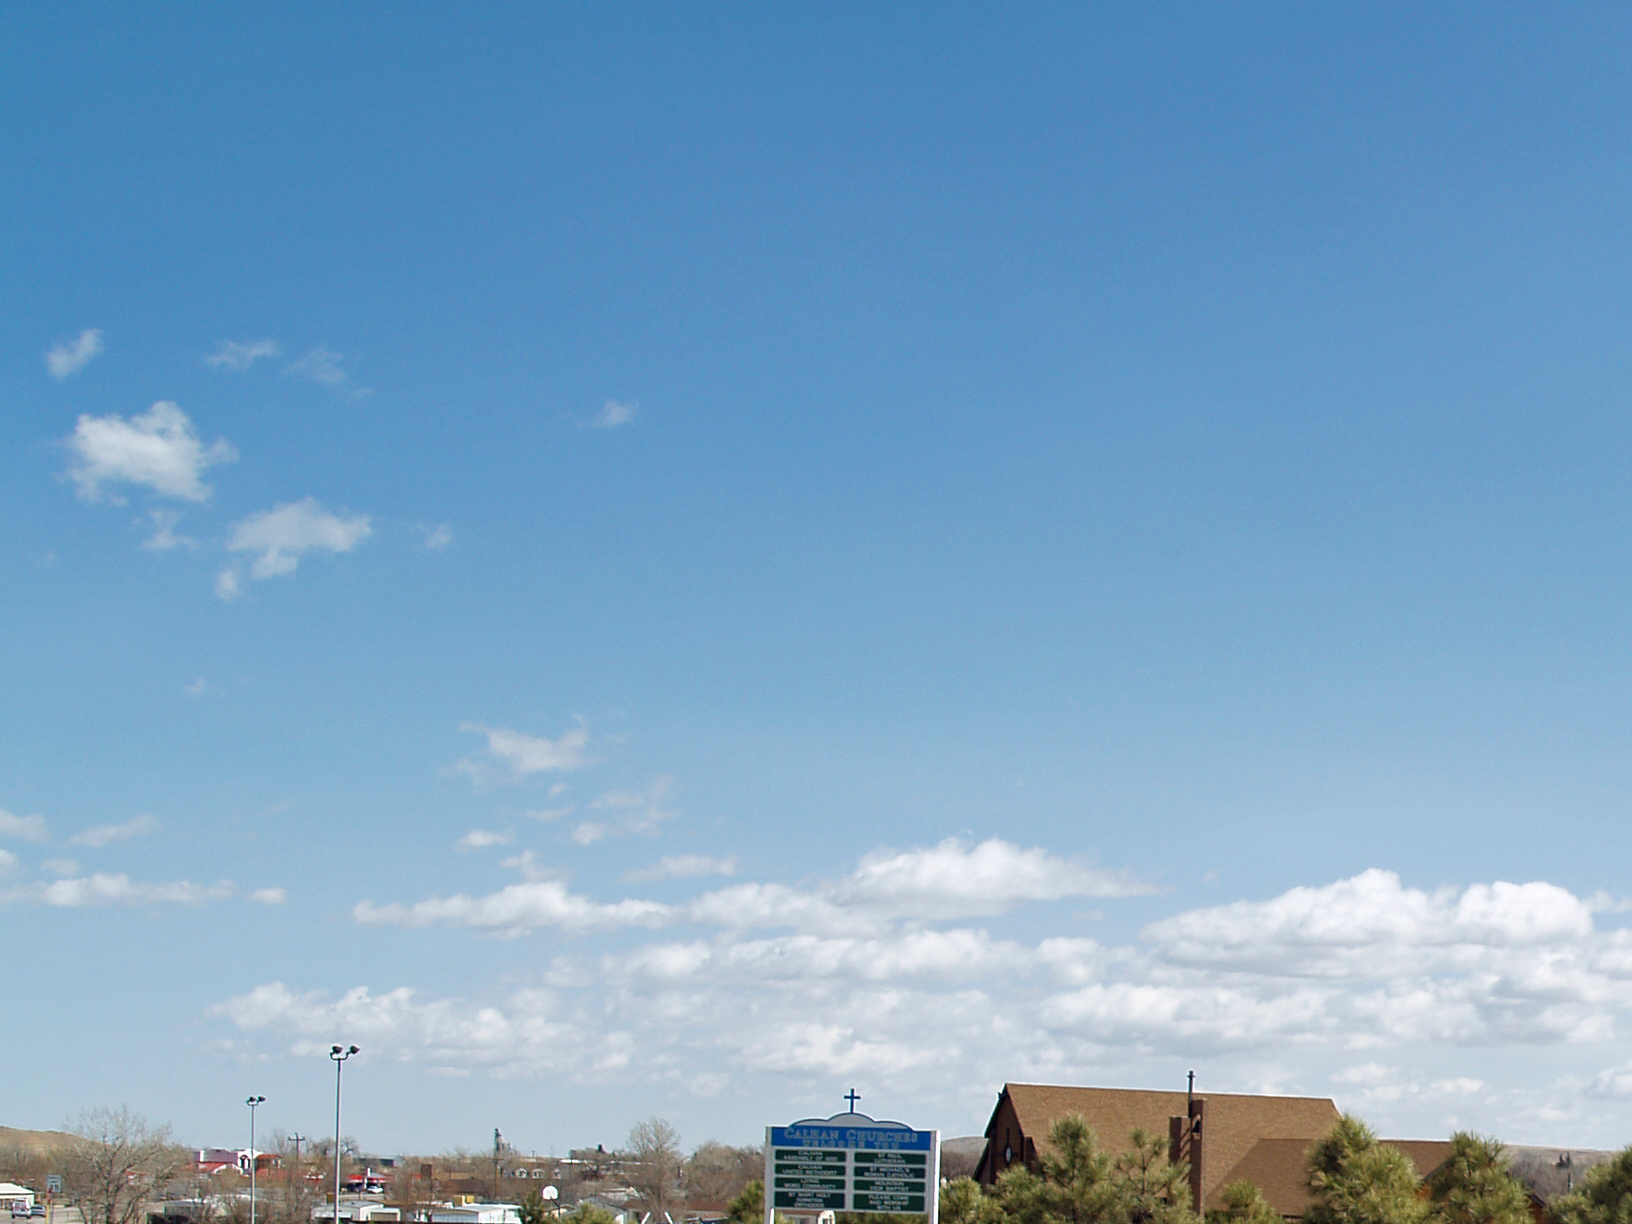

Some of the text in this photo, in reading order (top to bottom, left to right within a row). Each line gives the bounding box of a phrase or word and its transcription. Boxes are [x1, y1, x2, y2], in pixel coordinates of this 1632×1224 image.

[784, 1128, 918, 1143] CALHAN CHURCHES
[802, 1140, 865, 1148] WELCOME
